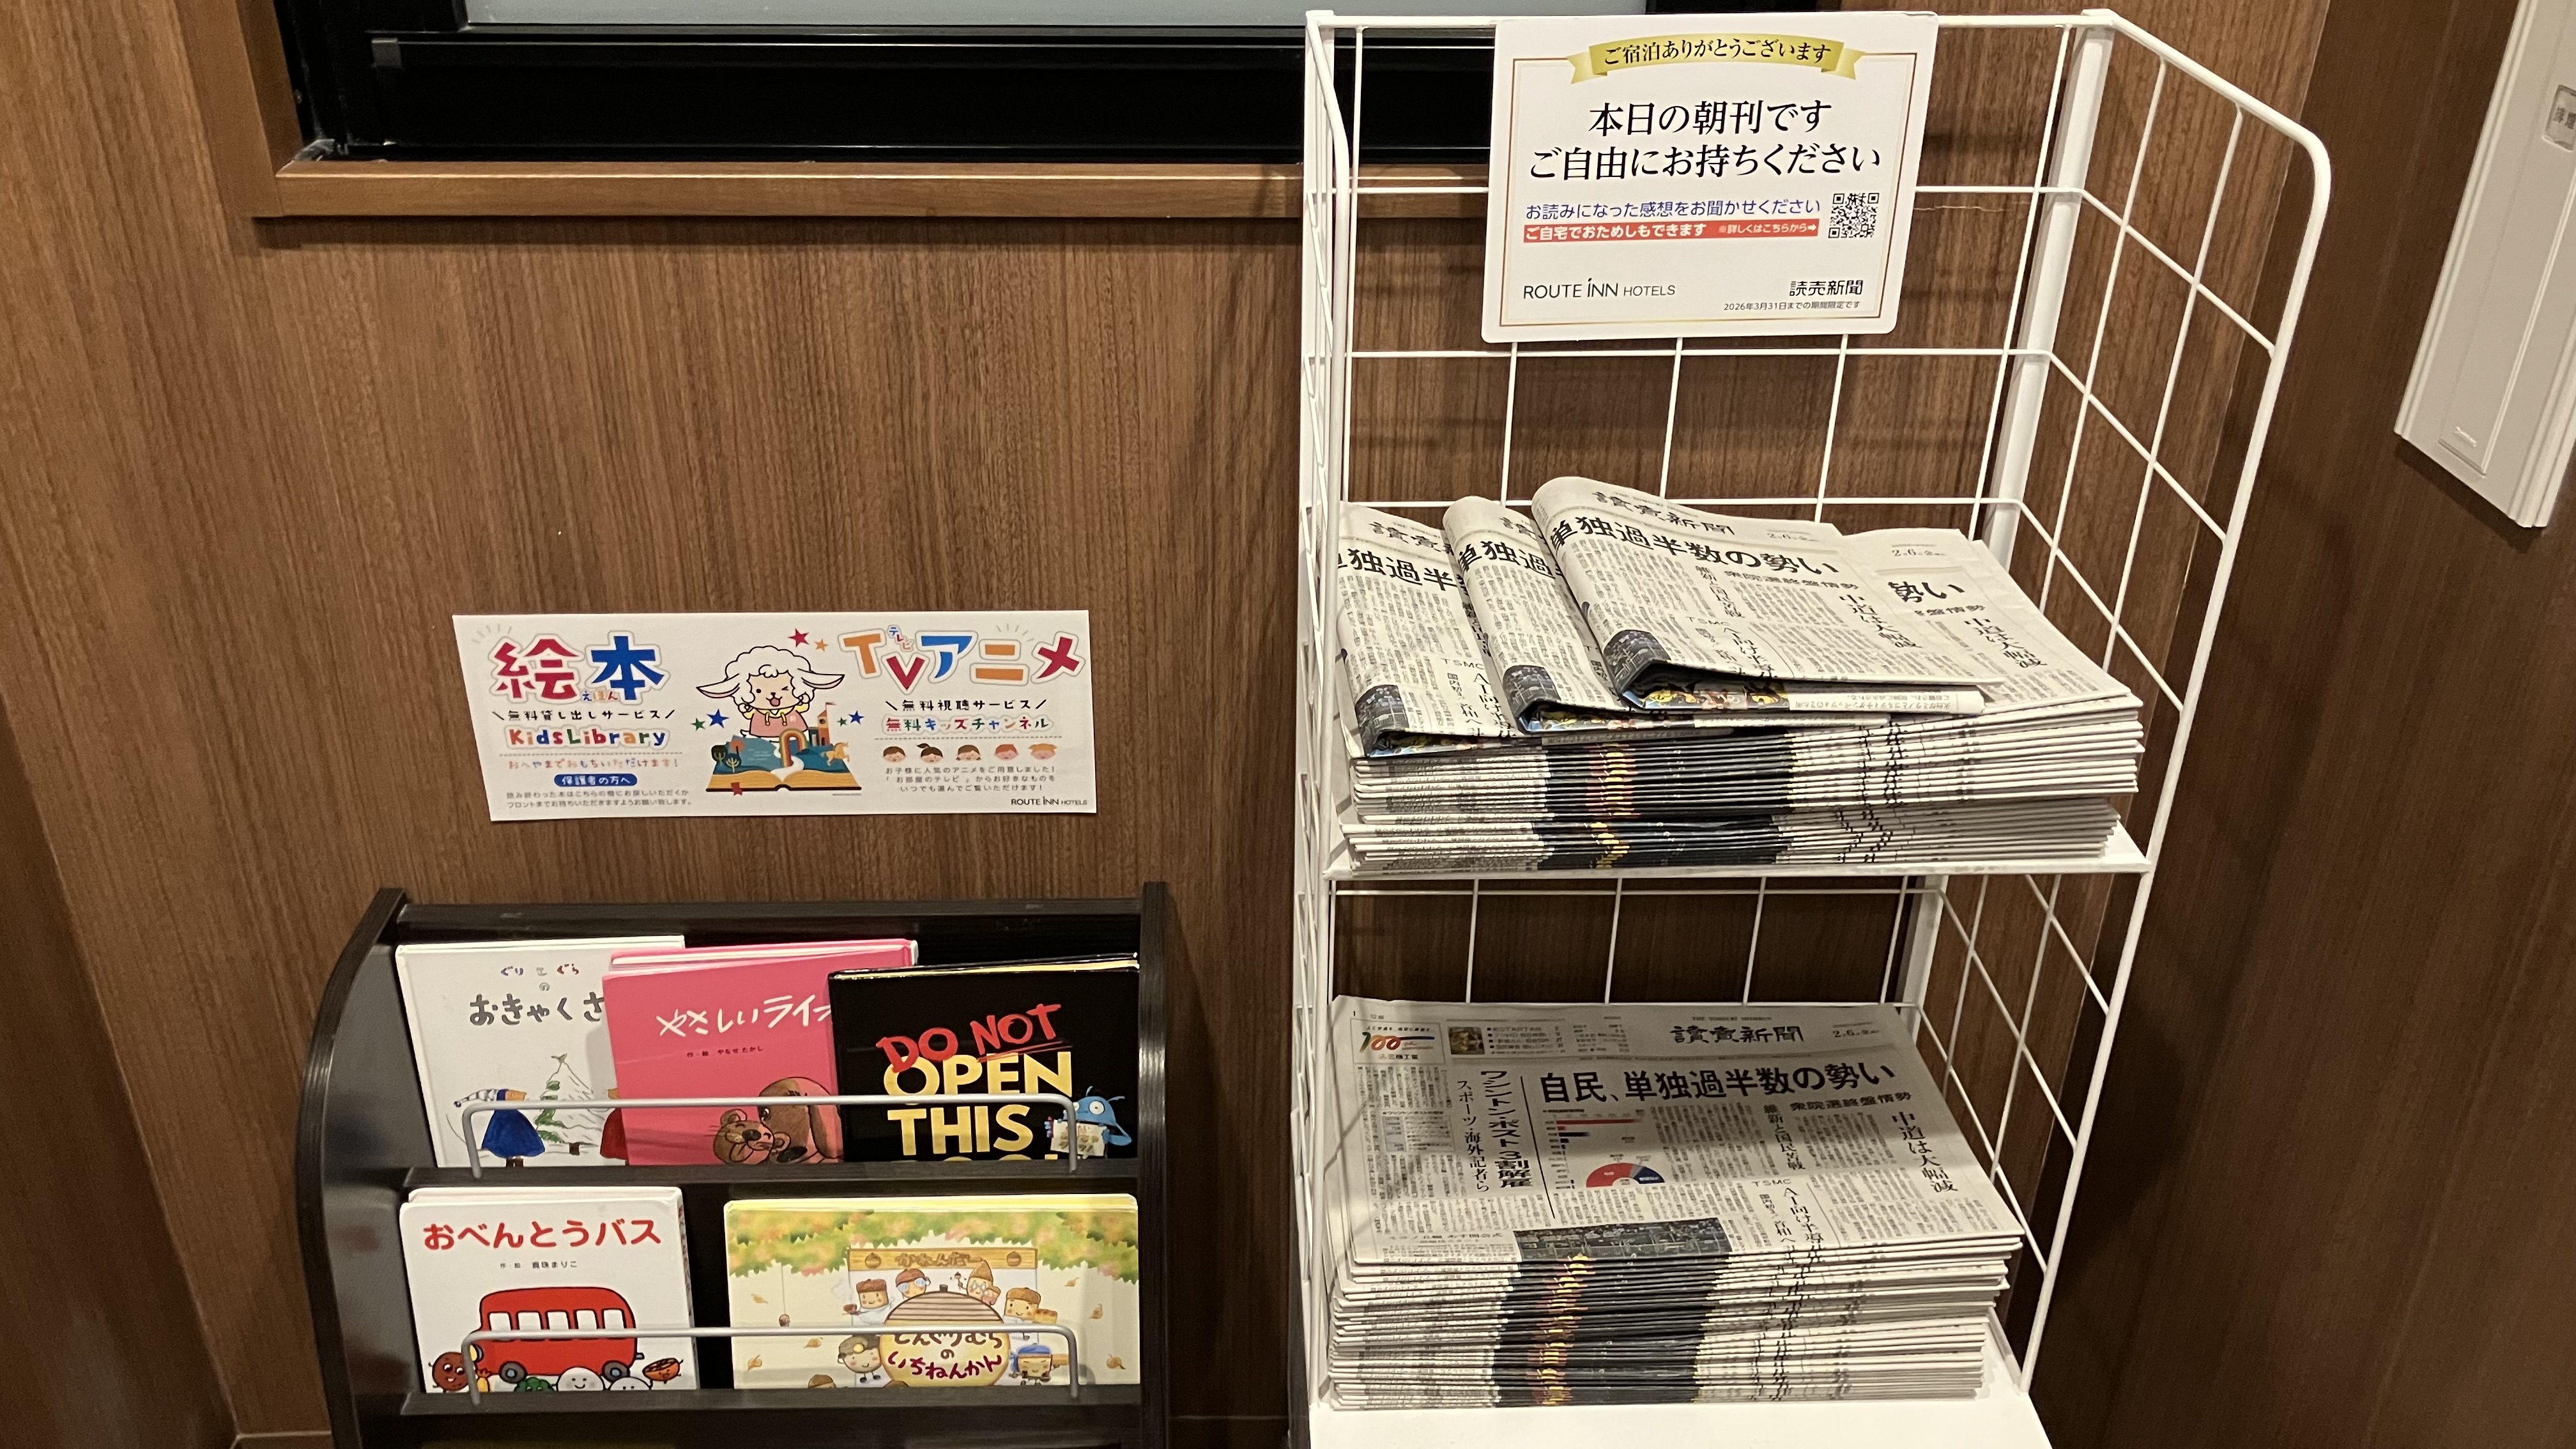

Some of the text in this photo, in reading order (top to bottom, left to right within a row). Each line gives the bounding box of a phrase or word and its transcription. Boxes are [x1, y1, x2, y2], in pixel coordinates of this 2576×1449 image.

[1604, 38, 1832, 65] ご宿泊ありがとうございます
[1588, 99, 1832, 137] 本日の朝刊です
[1529, 142, 1880, 181] ご自由にお持ちください
[1526, 199, 1820, 220] お読みになった感想をお聞かせください
[1525, 223, 1707, 241] ご自宅でおためしもできます
[1523, 284, 1582, 300] ROUTE
[1623, 284, 1676, 297] HOTELS
[1790, 279, 1864, 296] 読売新聞
[1724, 301, 1860, 311] 2026年3月31日までの期間限定です
[1551, 516, 1839, 576] 単独過半数の勢い
[1888, 581, 1965, 603] 勢い
[889, 626, 912, 651] テレビ
[494, 636, 664, 700] 絵本
[843, 633, 1080, 691] TVアニメ
[1441, 658, 1485, 670] TSMC
[582, 690, 618, 702] えほん
[901, 700, 1032, 712] 無料視聴サービス
[508, 709, 662, 721] 無料貸し出しサービス
[885, 717, 1050, 732] 無料キッズチャンネル
[508, 728, 666, 747] KidsLibrary
[539, 982, 550, 991] の
[876, 1003, 1062, 1073] DO NOT
[884, 1052, 1072, 1105] OPEN
[1540, 1062, 1896, 1104] 自民、単独過半数の勢い
[887, 1105, 1034, 1156] THIS
[1891, 1111, 1958, 1193] 中道は大幅減
[1752, 1179, 1792, 1187] TSMC
[423, 1218, 661, 1250] おべんとうバス
[888, 1351, 1002, 1379] いちねんかん
[940, 1349, 954, 1359] の
